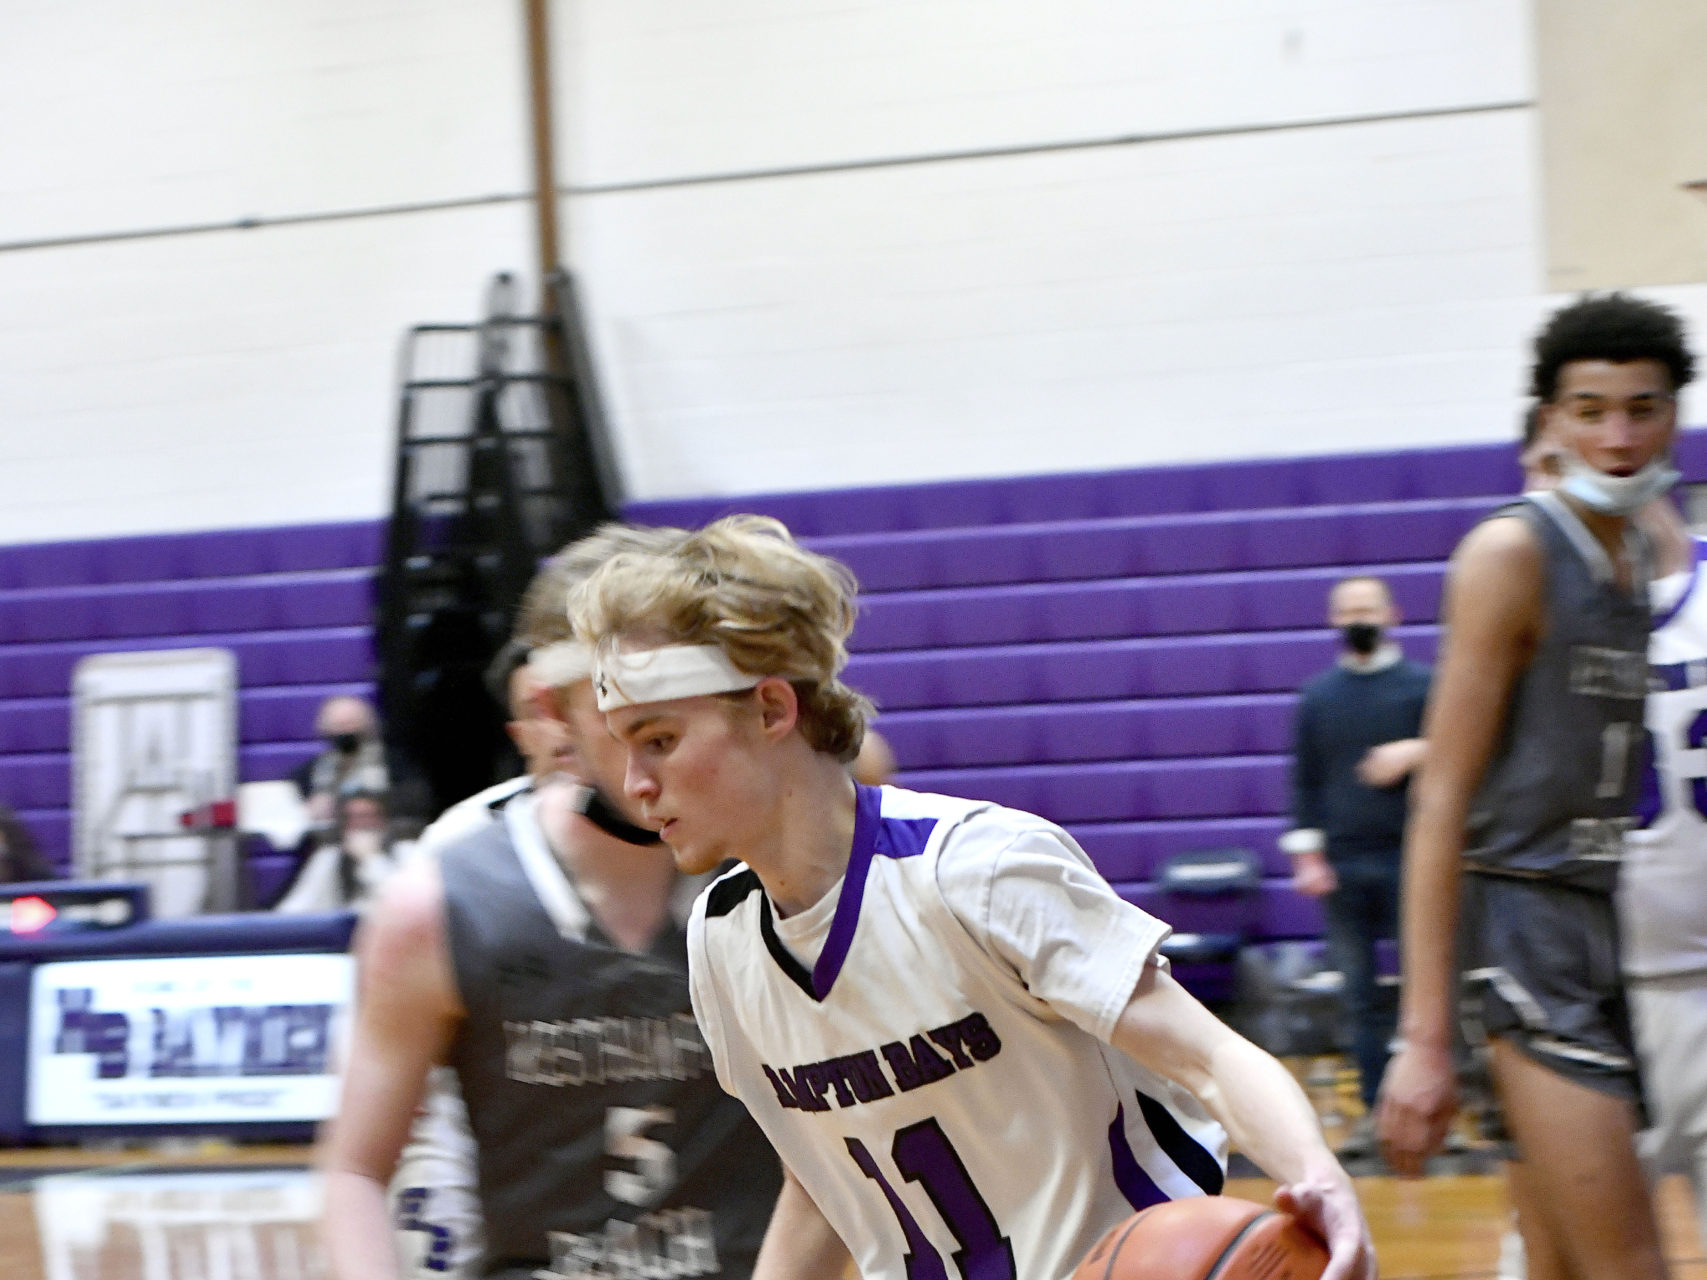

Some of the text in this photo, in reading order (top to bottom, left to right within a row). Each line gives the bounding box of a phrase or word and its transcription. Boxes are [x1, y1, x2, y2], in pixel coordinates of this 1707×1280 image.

[761, 1011, 1002, 1112] AMPTON BAYS
[603, 1106, 677, 1206] 5
